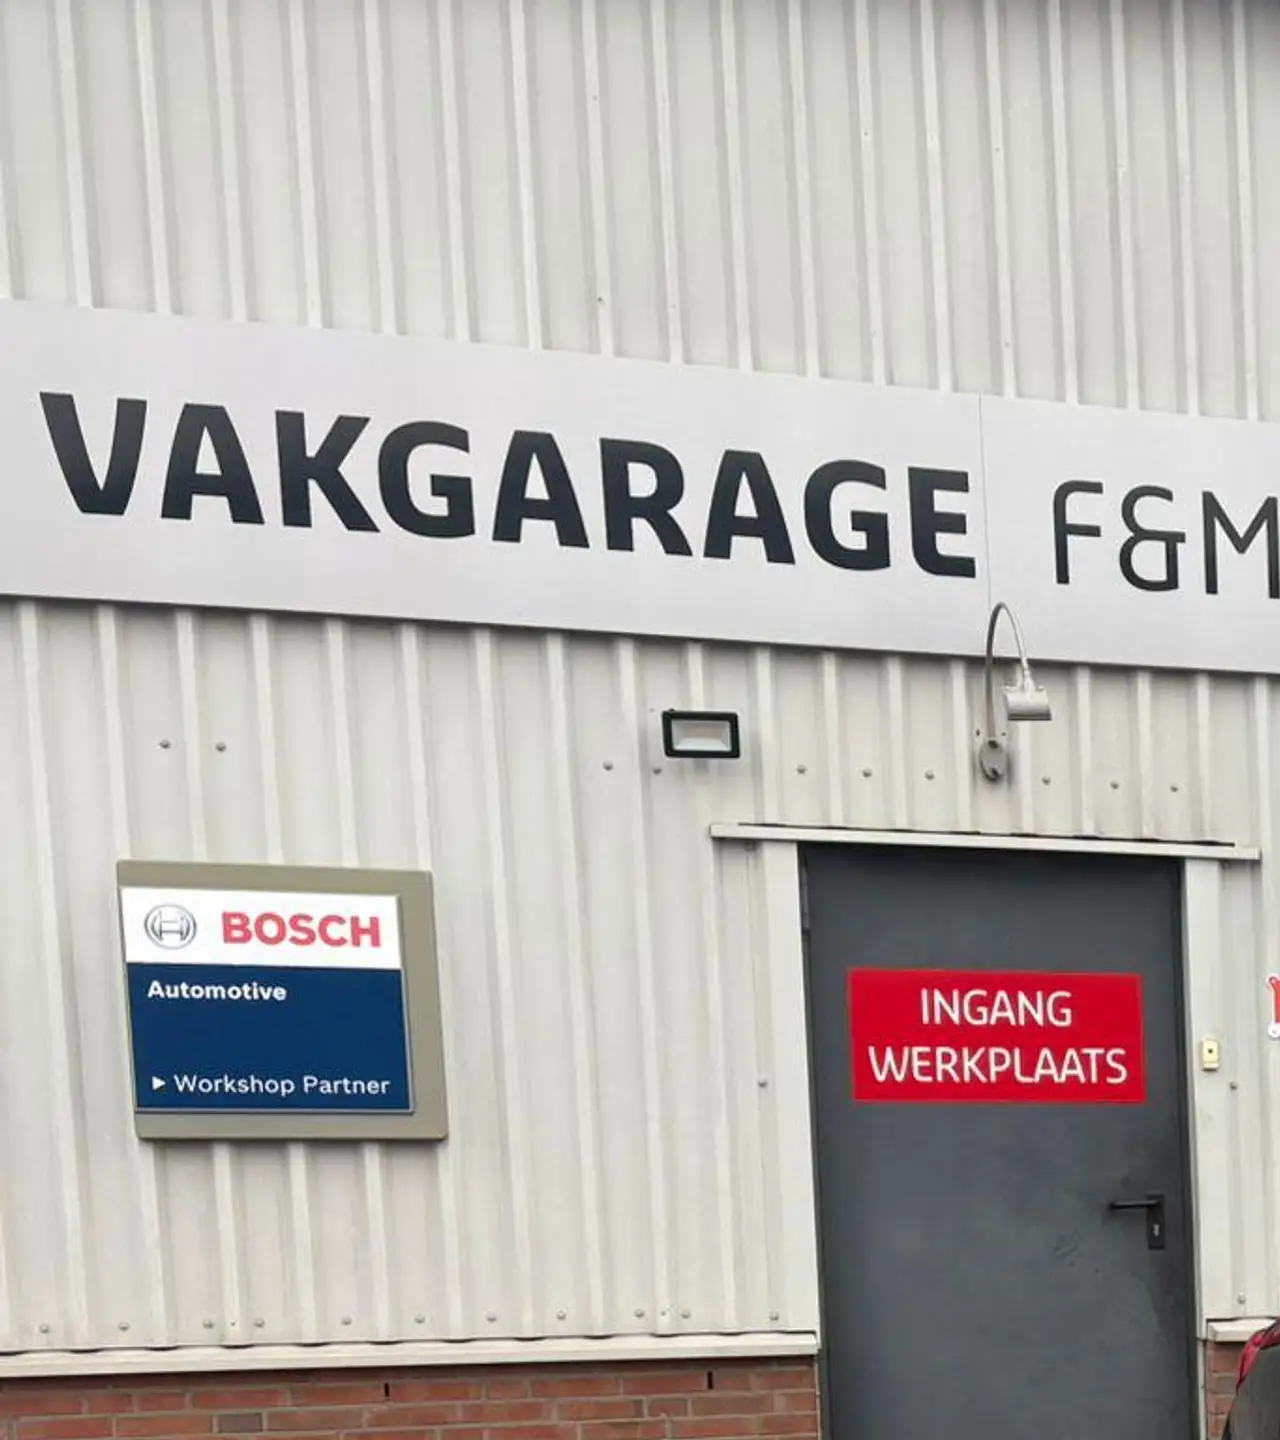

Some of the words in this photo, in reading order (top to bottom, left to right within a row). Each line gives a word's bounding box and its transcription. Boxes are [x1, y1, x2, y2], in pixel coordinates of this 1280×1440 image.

[39, 391, 977, 578] VAKGARAGE
[221, 911, 382, 948] BOSCH
[147, 980, 288, 1002] Automotive
[920, 987, 1073, 1028] INGANG
[867, 1045, 1128, 1085] WERKPLAATS
[173, 1074, 296, 1097] Workshop
[303, 1076, 391, 1096] Partner
